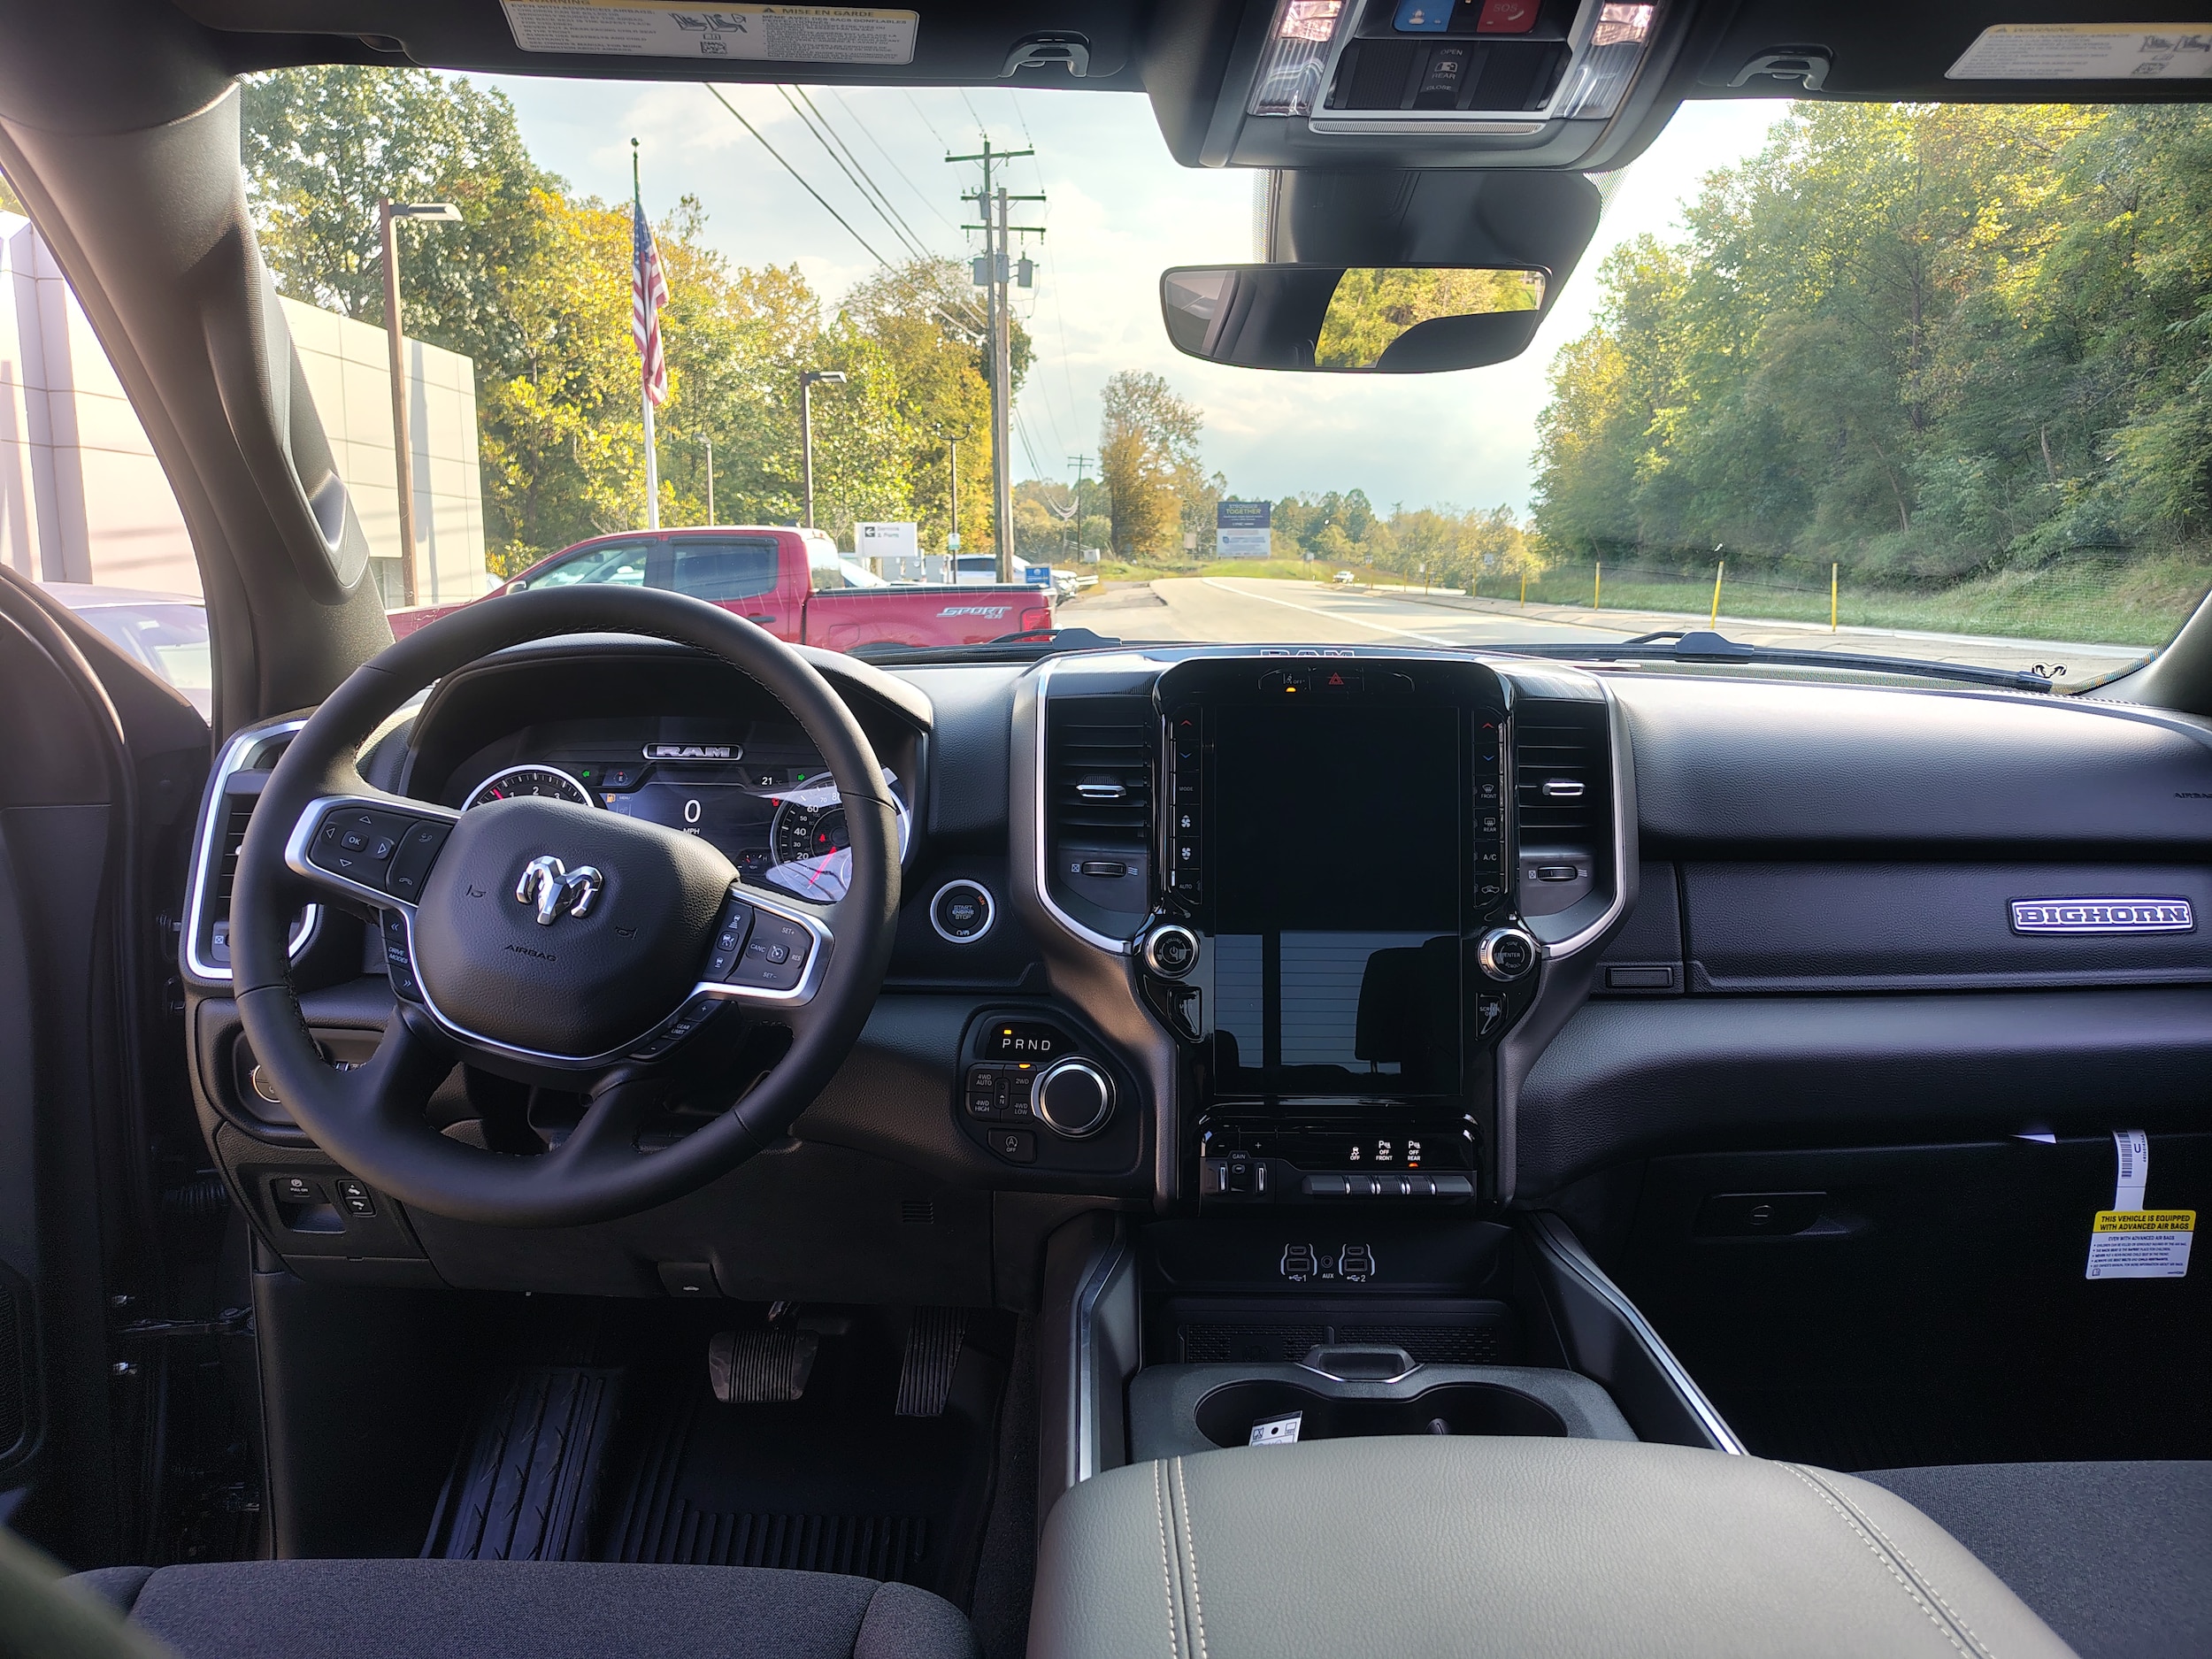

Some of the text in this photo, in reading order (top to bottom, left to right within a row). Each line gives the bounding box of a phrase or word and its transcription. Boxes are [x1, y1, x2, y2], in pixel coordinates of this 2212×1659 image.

[936, 606, 1012, 618] SPORT
[656, 746, 730, 757] RAM
[762, 777, 772, 786] 21
[533, 787, 539, 795] 2
[684, 799, 702, 823] 0
[348, 836, 362, 846] OK
[2016, 906, 2190, 926] BIGHORN
[388, 946, 405, 956] DRIVE
[504, 944, 557, 962] AIRBAG
[750, 943, 766, 953] CANC
[388, 953, 408, 964] MODES
